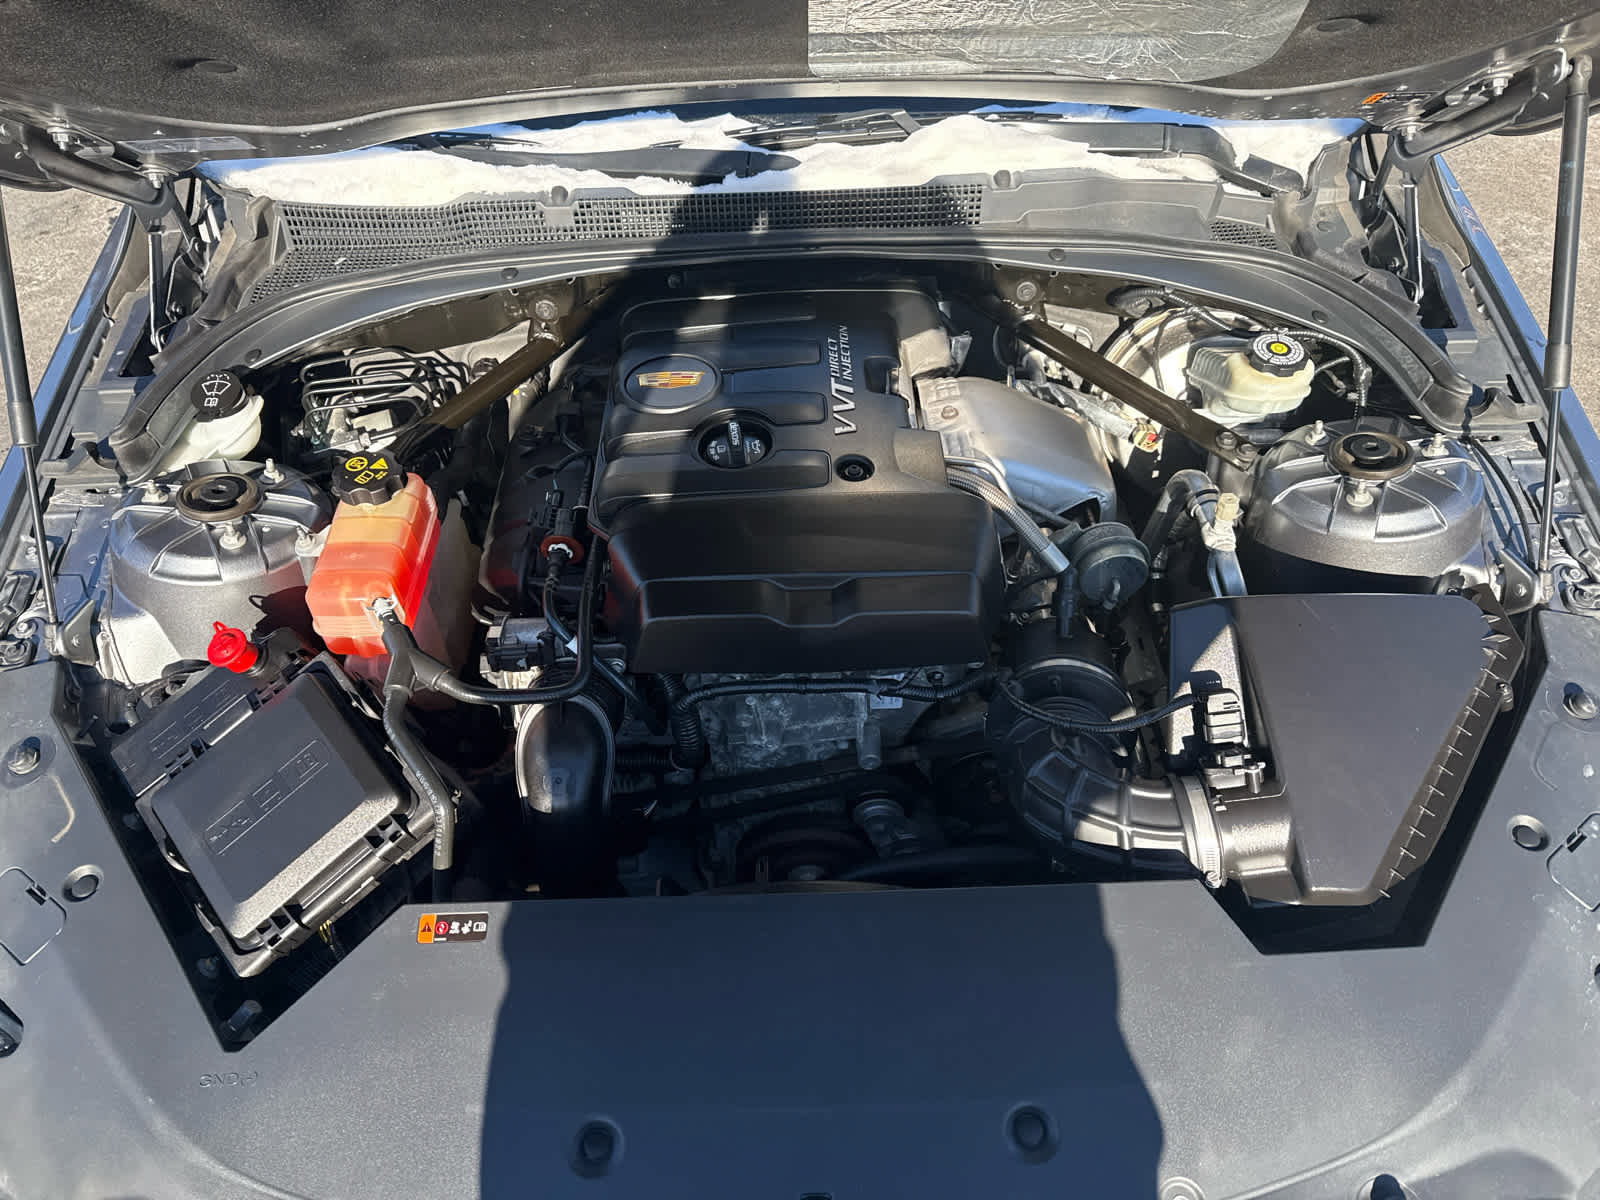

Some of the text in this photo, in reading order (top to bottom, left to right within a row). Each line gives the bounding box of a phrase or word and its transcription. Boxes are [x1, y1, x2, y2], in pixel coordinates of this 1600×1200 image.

[828, 337, 840, 377] DIRECT
[839, 325, 853, 381] INJECTION
[830, 377, 857, 435] VVT
